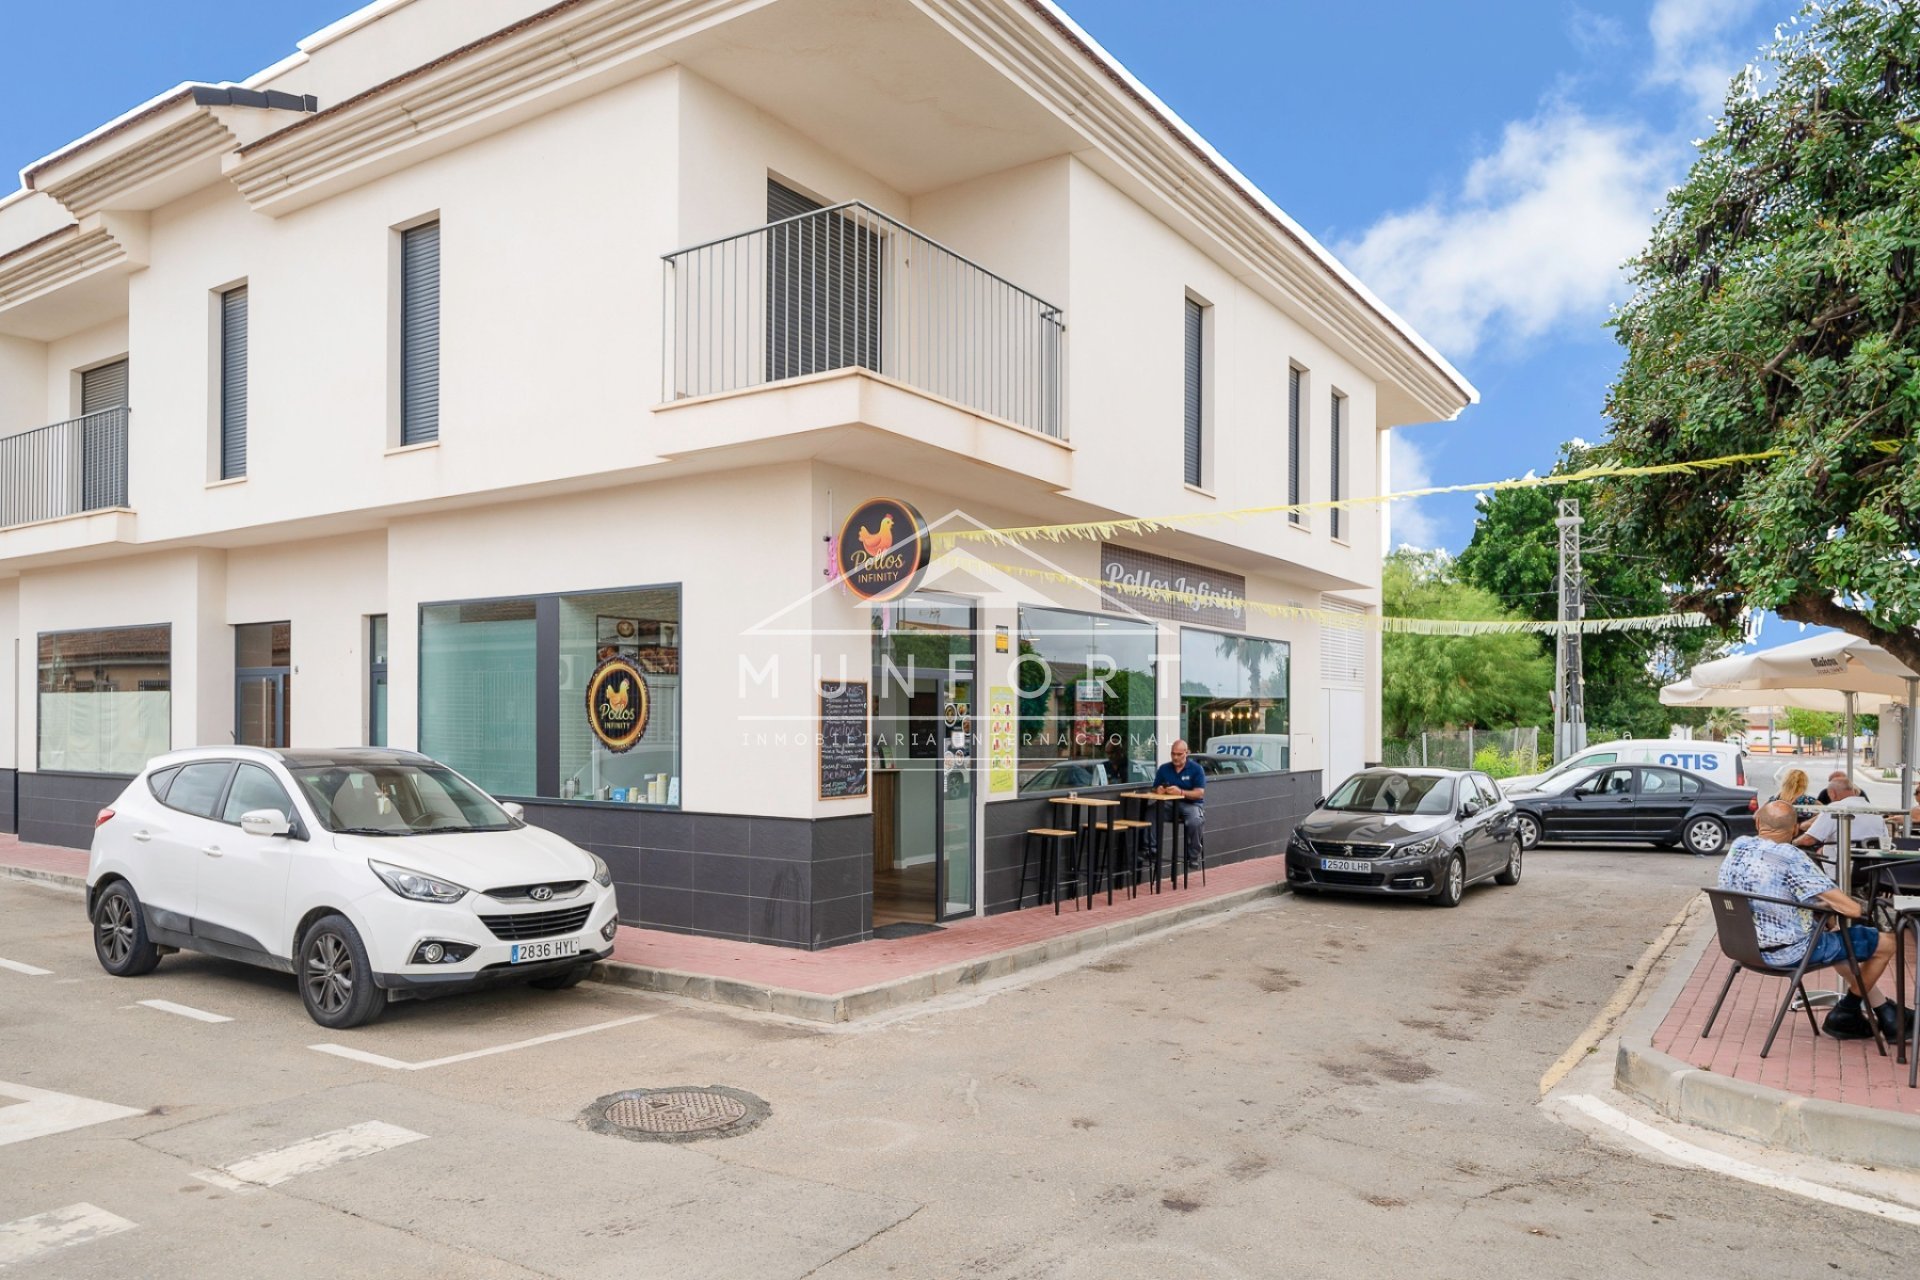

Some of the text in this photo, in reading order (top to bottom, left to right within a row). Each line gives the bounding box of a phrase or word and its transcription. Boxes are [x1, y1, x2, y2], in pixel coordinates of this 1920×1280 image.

[851, 549, 903, 572] Pollos
[858, 572, 898, 583] INFINITY
[1105, 562, 1169, 597] Pollos
[600, 703, 635, 720] Pollos
[1659, 753, 1719, 771] OTIS
[1327, 861, 1370, 872] 2520 LHR
[520, 940, 577, 960] 2836 HYL
